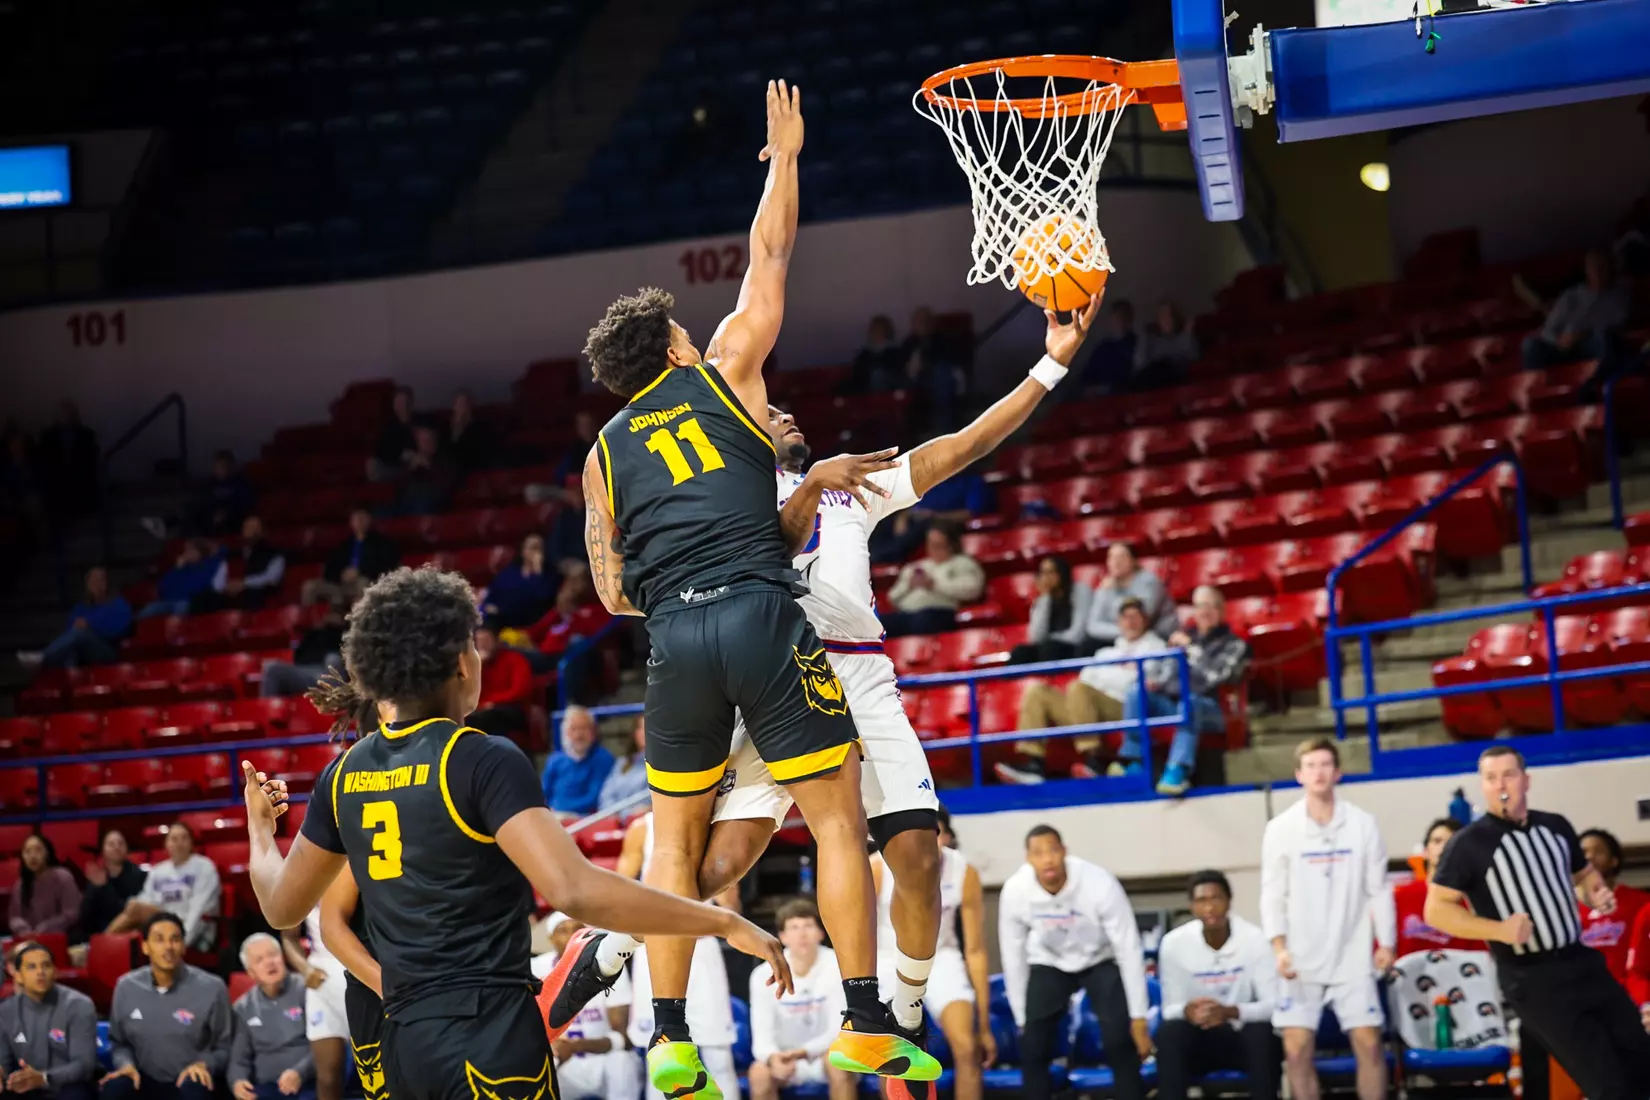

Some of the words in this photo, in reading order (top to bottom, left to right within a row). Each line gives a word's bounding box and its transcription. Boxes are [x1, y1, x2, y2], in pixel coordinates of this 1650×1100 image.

[678, 244, 745, 284] 102
[66, 309, 127, 348] 101
[628, 402, 692, 433] JOHNSON
[644, 417, 726, 487] 11
[343, 765, 413, 794] WASHINGTON
[414, 763, 431, 786] III
[361, 799, 404, 881] 3
